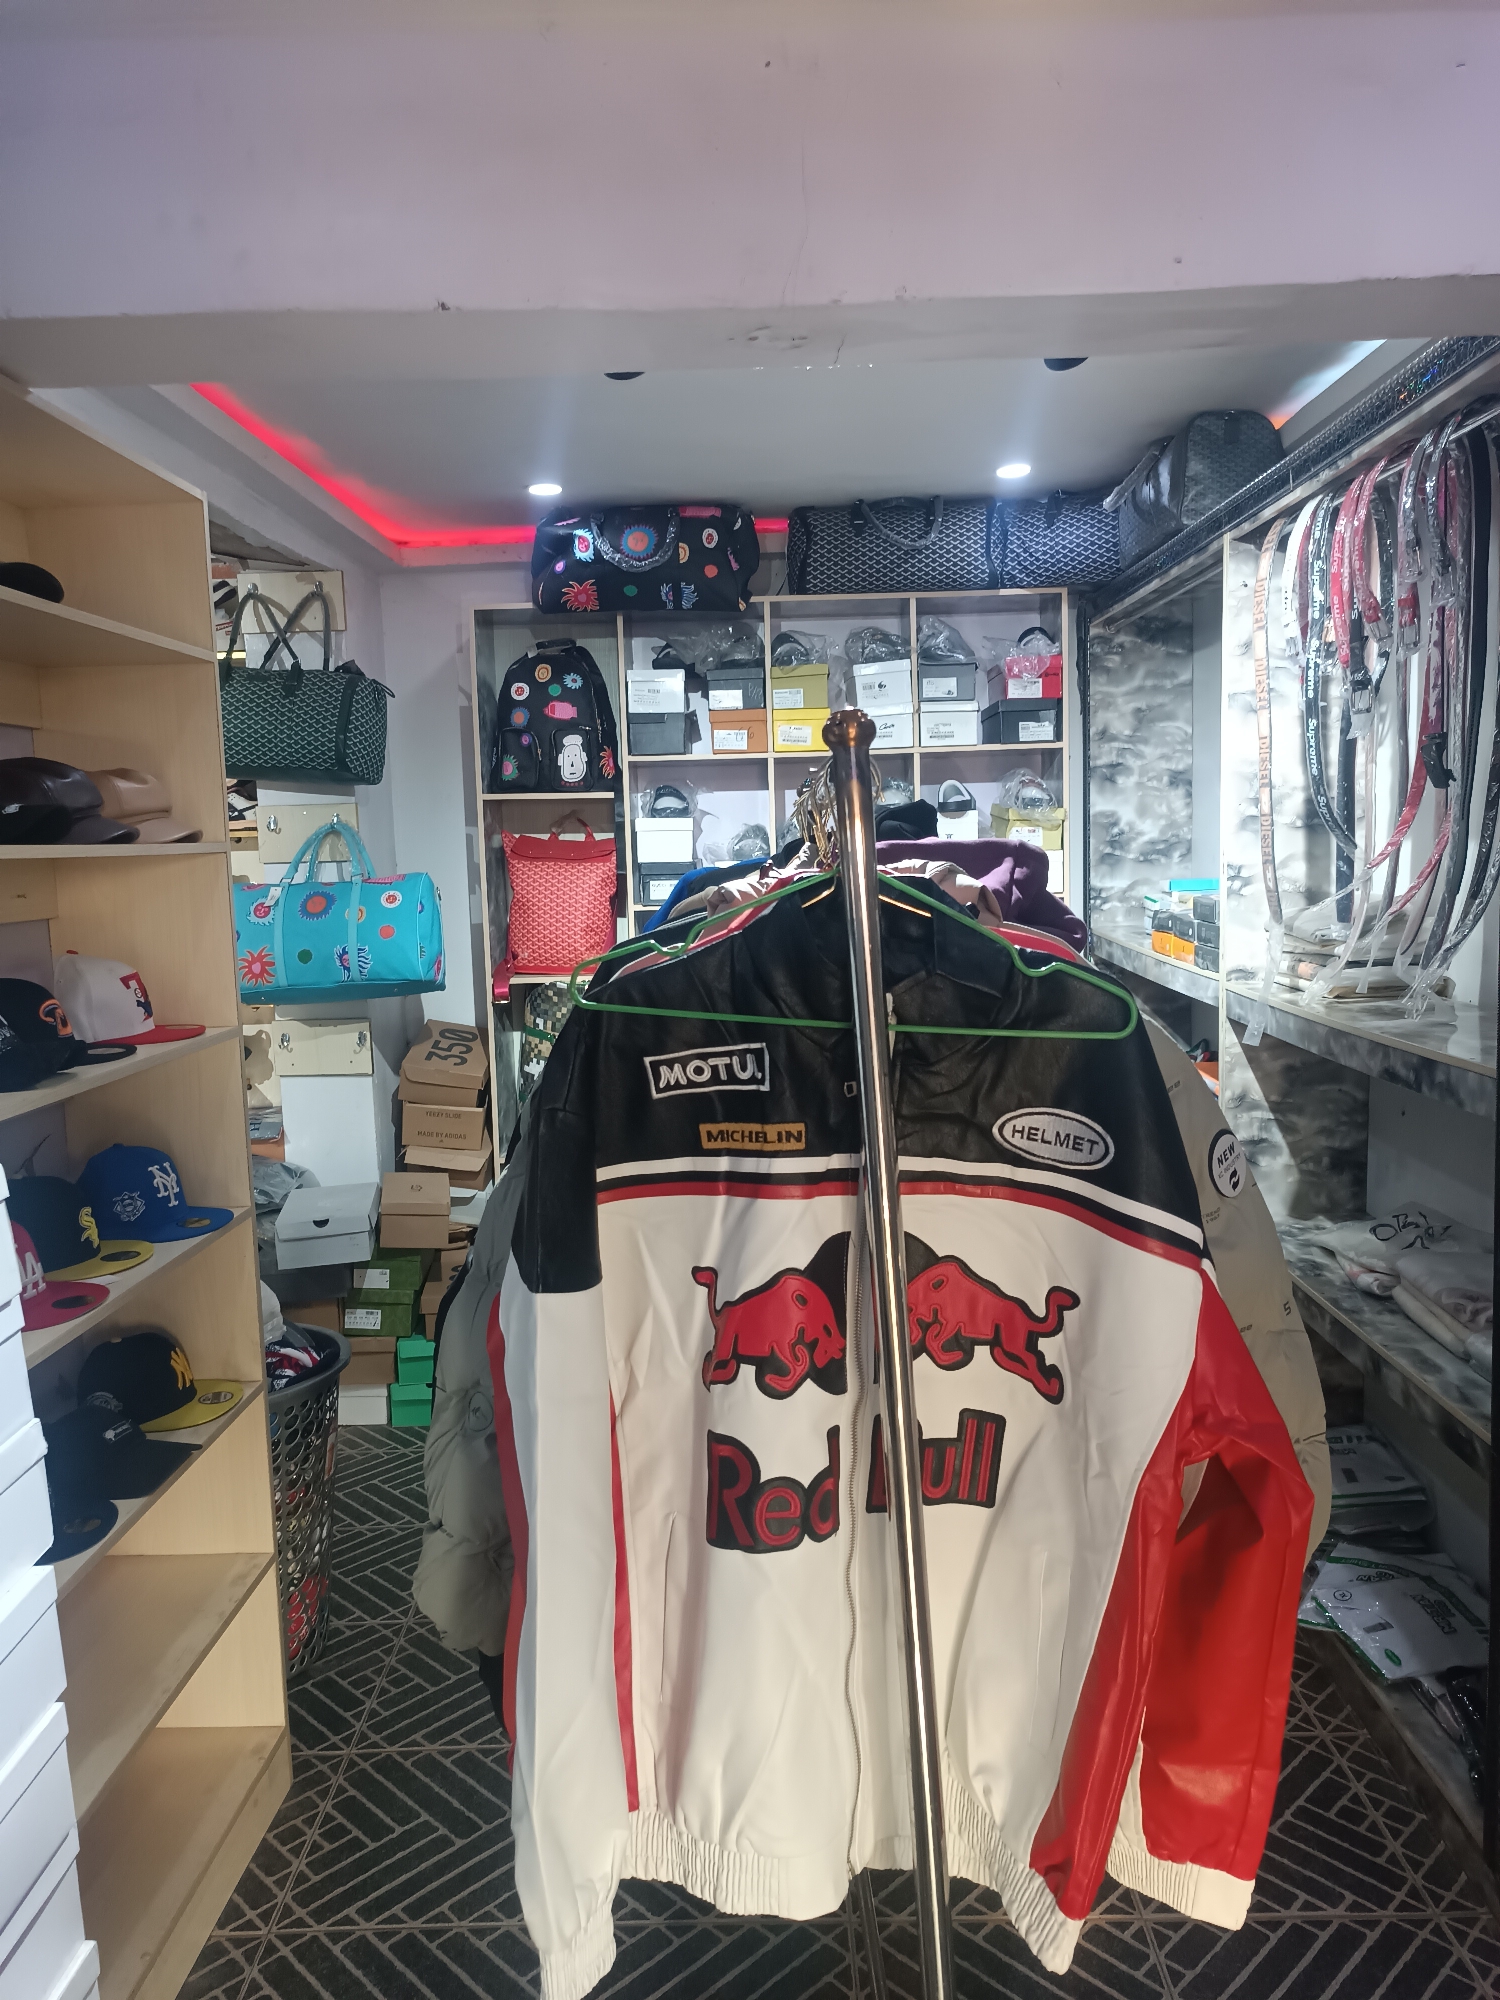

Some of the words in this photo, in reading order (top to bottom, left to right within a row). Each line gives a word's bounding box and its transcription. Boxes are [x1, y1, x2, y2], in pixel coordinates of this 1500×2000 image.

[1254, 577, 1267, 631] DIESEL
[1333, 595, 1349, 656] Supreme
[1254, 657, 1269, 711] DIESEL
[1306, 637, 1320, 699] Supreme
[1258, 735, 1271, 788] DIESEL
[1306, 717, 1319, 776] Supreme
[1260, 813, 1273, 865] DIESEL
[424, 1028, 479, 1067] 350
[417, 1130, 434, 1138] MADE
[444, 1132, 467, 1140] ADIDAS
[425, 1110, 444, 1119] YEEZY
[444, 1112, 462, 1120] SLIDE
[706, 1129, 803, 1144] MICHELIN
[1011, 1123, 1099, 1156] HELMET
[1216, 1141, 1235, 1169] NEW
